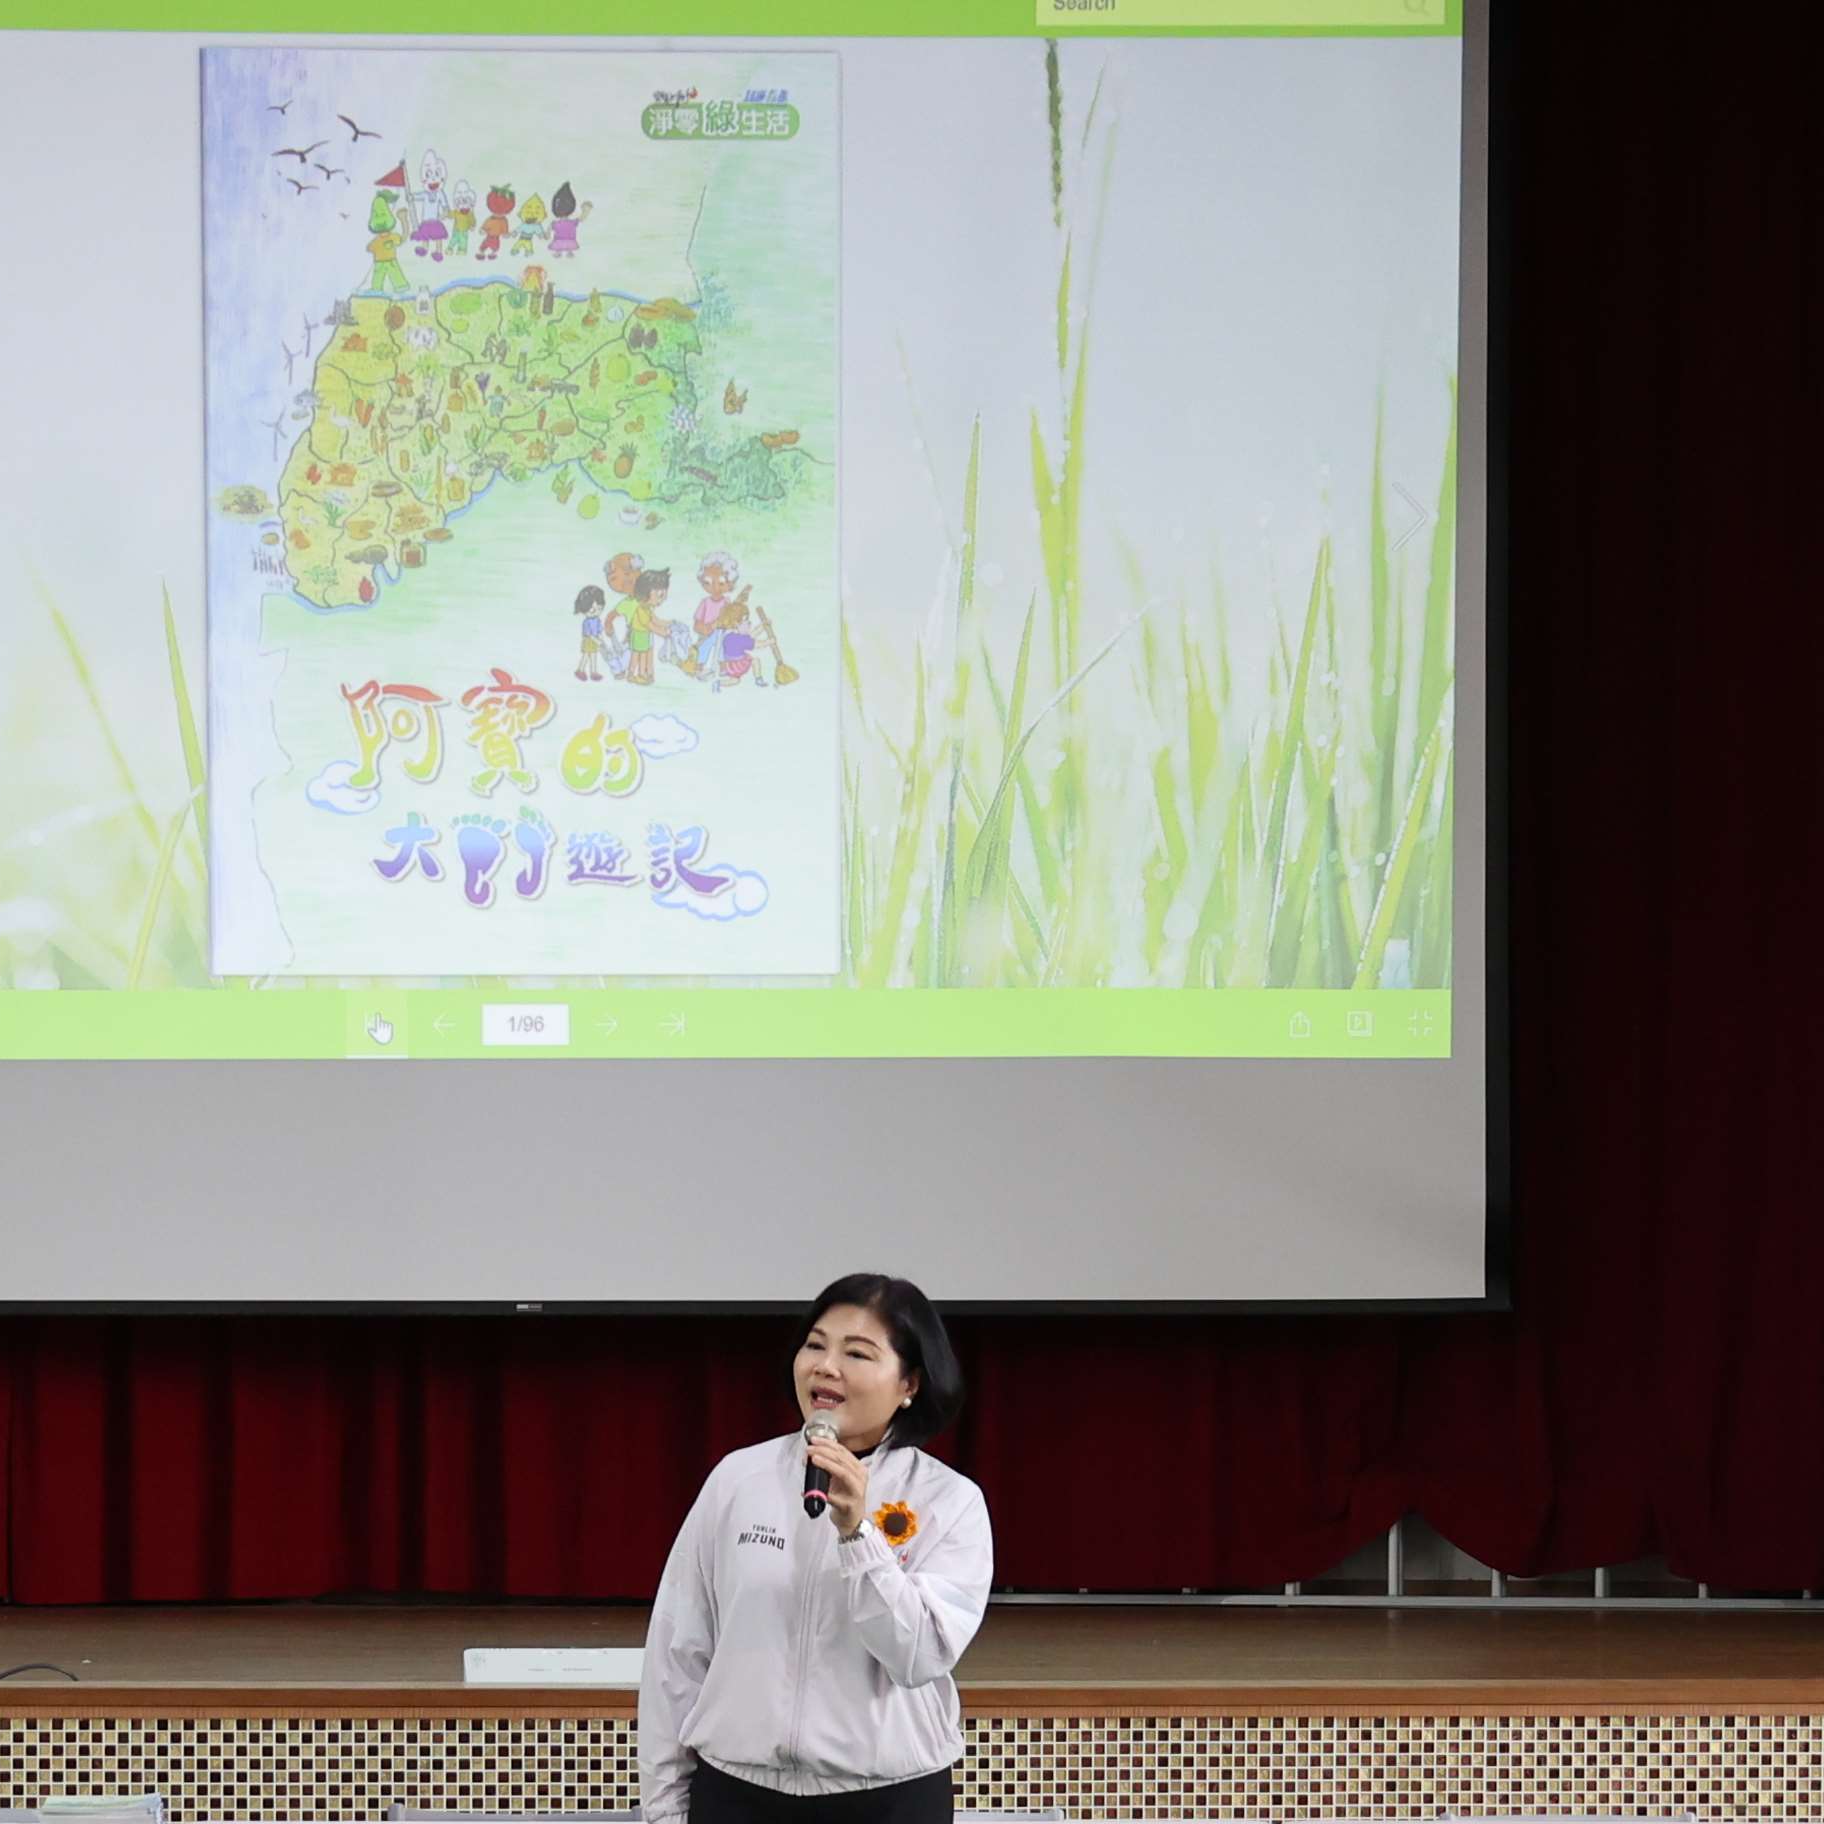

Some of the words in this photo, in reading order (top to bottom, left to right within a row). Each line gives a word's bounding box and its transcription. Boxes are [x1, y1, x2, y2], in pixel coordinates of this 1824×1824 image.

[341, 669, 641, 795] 阿寶的
[507, 1015, 545, 1032] 1/96
[737, 1532, 785, 1550] MIZUNO
